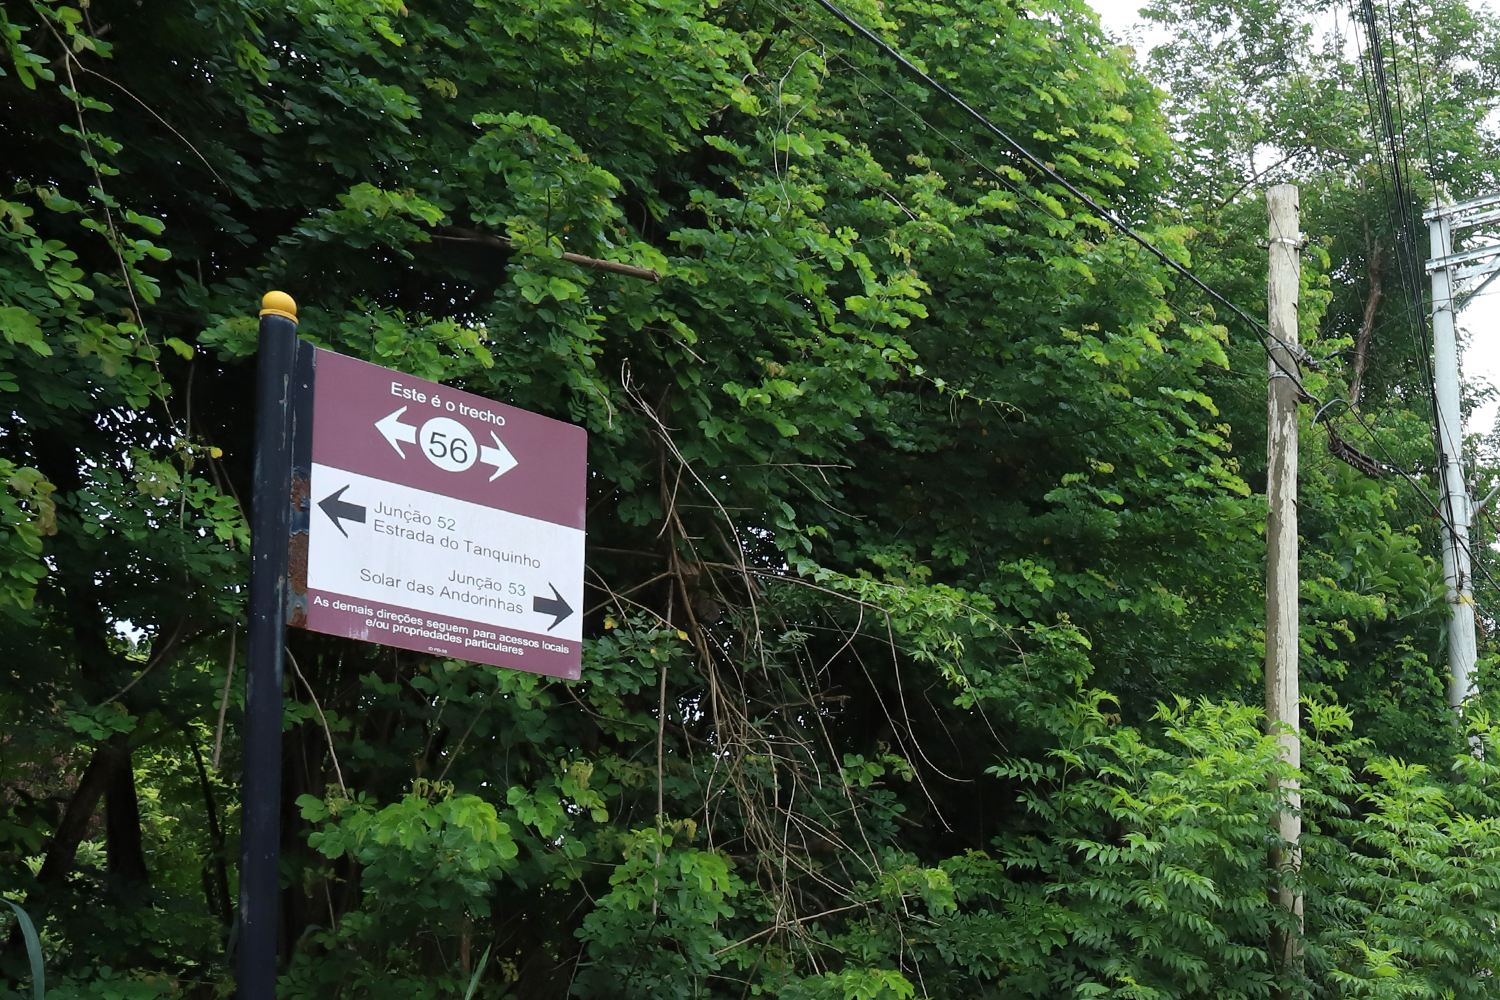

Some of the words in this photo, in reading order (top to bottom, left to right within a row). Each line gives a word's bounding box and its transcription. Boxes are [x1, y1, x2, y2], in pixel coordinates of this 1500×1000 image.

[391, 381, 427, 404] Este
[431, 393, 442, 408] é
[445, 400, 456, 412] o
[459, 402, 506, 427] trecho
[428, 431, 469, 464] 56
[374, 501, 432, 526] Junção
[437, 516, 456, 532] 52
[374, 519, 435, 545] Estrada
[440, 536, 459, 550] do
[463, 539, 541, 569] Tanquinho
[360, 568, 402, 589] Solar
[406, 579, 435, 596] das
[439, 585, 524, 614] Andorinhas
[448, 569, 502, 592] Junção
[508, 582, 527, 597] 53
[313, 595, 330, 608] As
[332, 600, 374, 616] demais
[376, 609, 424, 626] direções
[426, 618, 469, 635] seguem
[473, 628, 496, 640] para
[499, 634, 540, 649] acessos
[542, 640, 570, 654] locais
[365, 618, 390, 630] e/ou
[392, 623, 463, 644] propriedades
[465, 637, 524, 656] particulares
